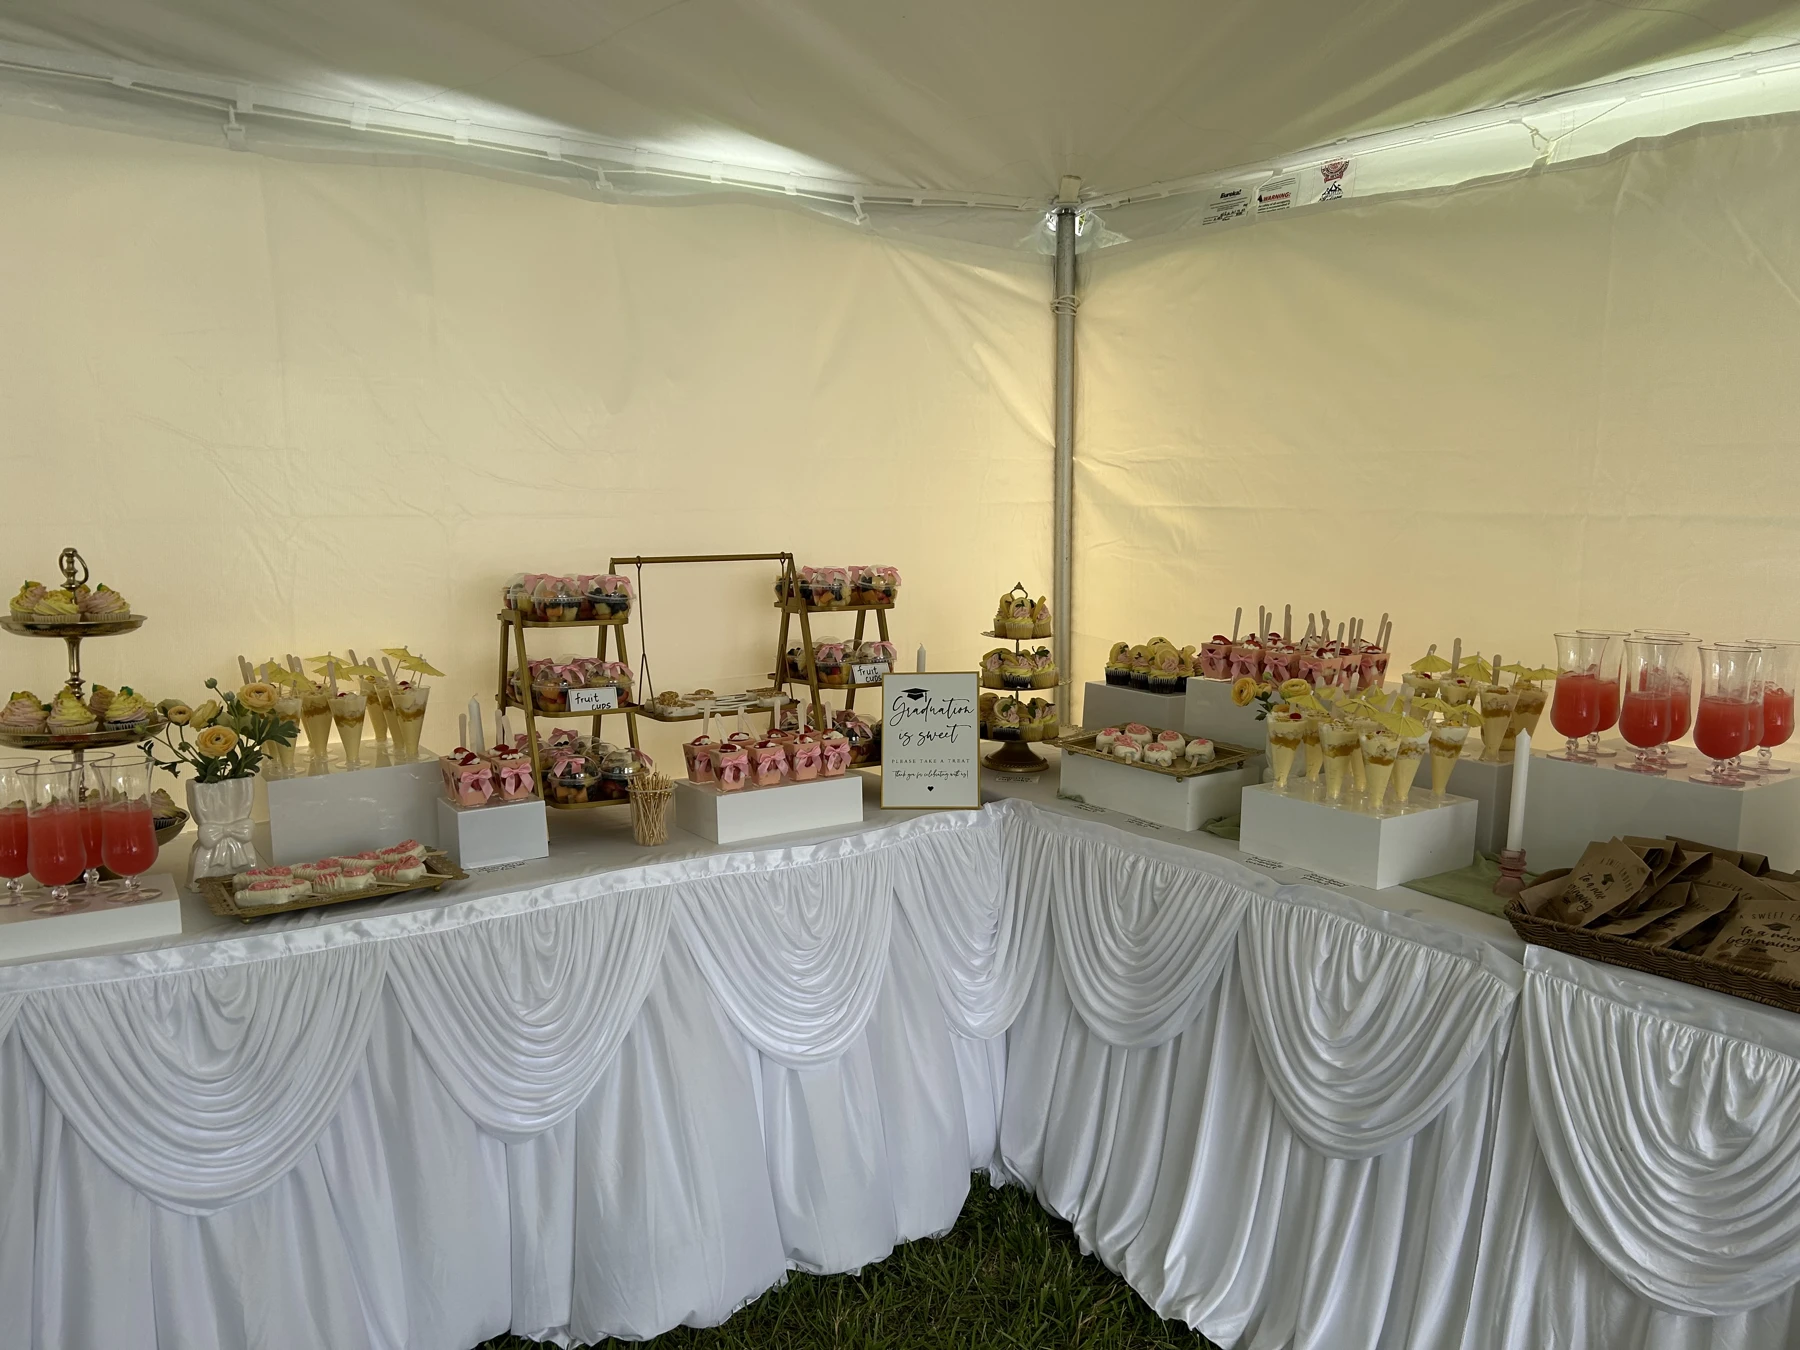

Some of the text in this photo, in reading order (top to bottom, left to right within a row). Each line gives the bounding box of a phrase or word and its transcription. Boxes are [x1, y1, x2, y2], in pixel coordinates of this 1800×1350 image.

[857, 666, 879, 676] fruit
[575, 693, 600, 704] fruit
[592, 702, 612, 711] cups
[889, 696, 975, 727] Graduation
[899, 724, 972, 747] is sweet
[1752, 911, 1785, 920] SWEET
[1741, 926, 1754, 936] to
